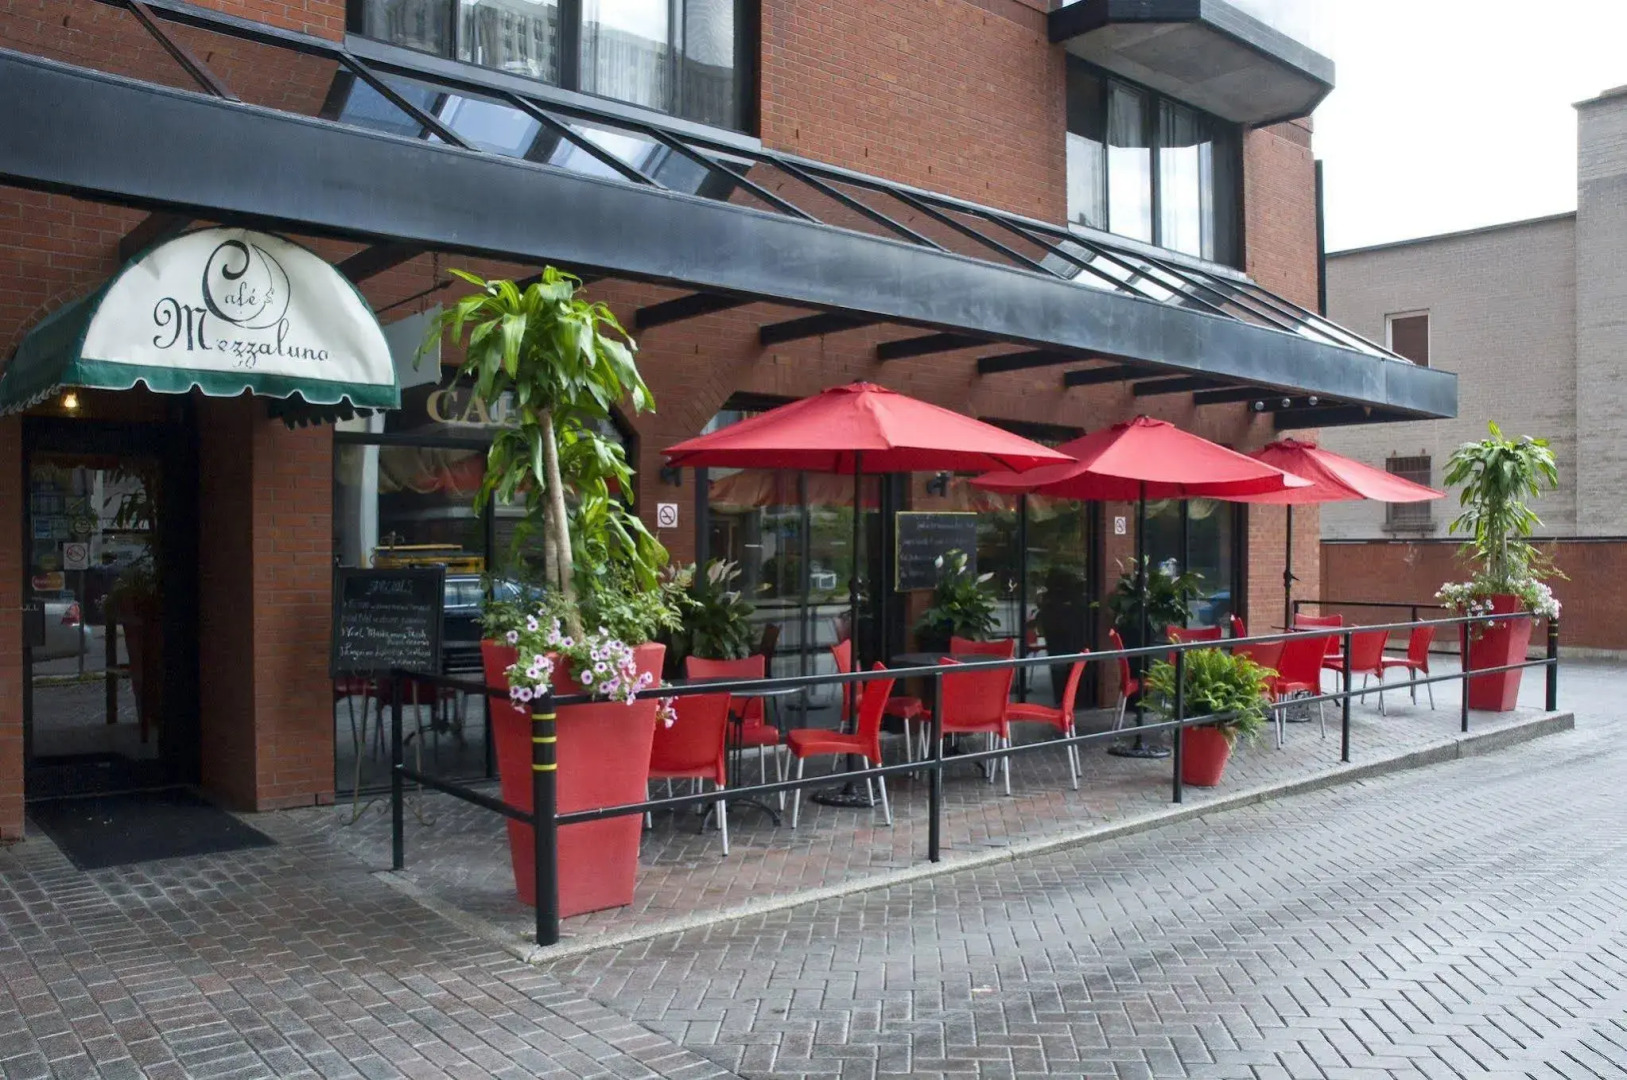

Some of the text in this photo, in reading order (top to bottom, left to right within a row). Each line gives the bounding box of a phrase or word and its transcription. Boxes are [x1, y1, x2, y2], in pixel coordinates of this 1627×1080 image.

[202, 239, 259, 323] Café
[153, 297, 329, 369] Mezzaluna
[426, 389, 519, 426] CAF
